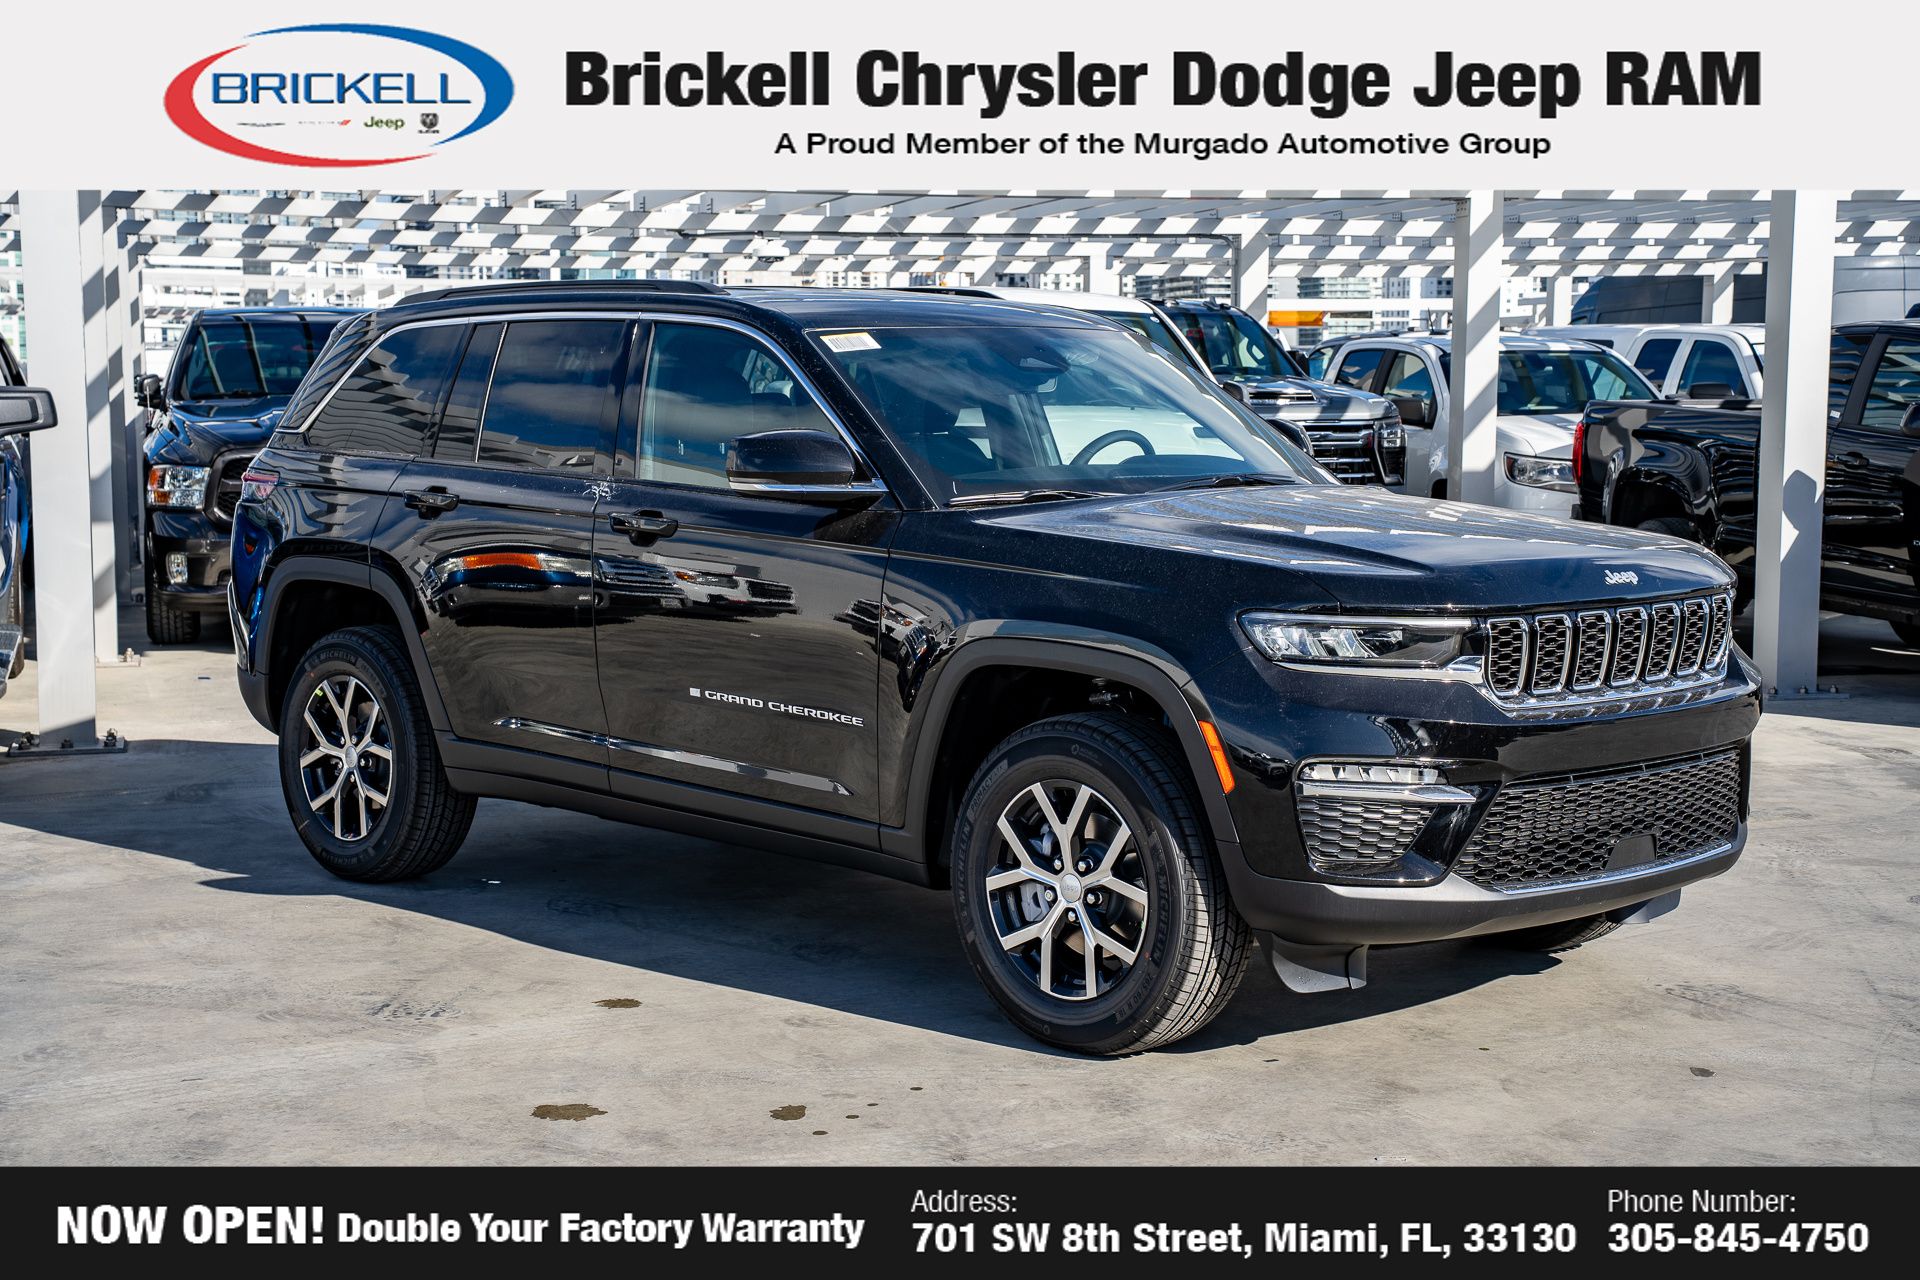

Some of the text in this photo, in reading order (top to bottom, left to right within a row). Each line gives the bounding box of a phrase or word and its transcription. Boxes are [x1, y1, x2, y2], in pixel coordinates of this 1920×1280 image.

[1604, 570, 1639, 586] Jeep
[705, 691, 864, 726] GRAND CHEROKEE
